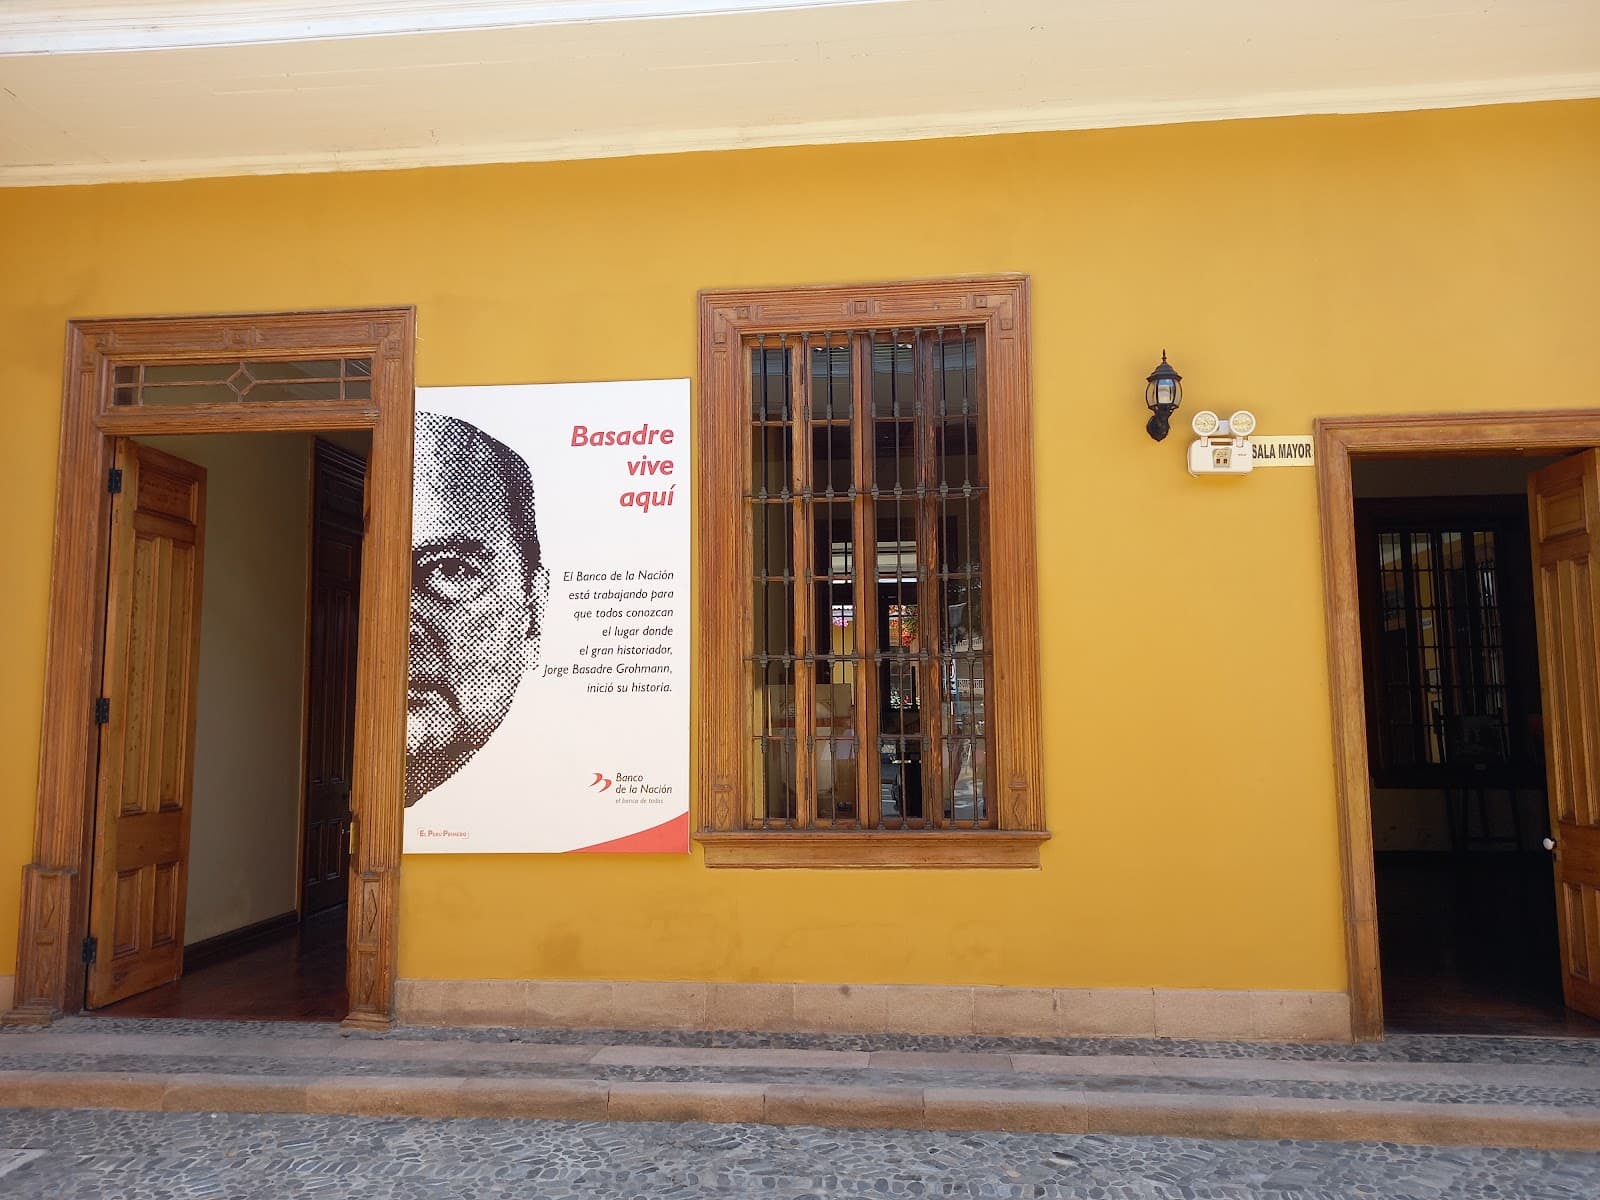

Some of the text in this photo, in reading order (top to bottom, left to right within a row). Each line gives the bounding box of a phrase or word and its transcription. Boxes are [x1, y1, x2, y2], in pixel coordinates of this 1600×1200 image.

[570, 424, 674, 447] Basadre
[1252, 443, 1312, 459] SALA MAYOR
[627, 455, 674, 476] vive
[619, 484, 676, 513] aquí
[563, 570, 674, 581] El Banco de la Nación
[568, 589, 674, 602] está trabajando para
[573, 607, 674, 621] que todos conozcan
[602, 625, 674, 639] el lugar donde
[579, 644, 673, 658] el gran historiador,
[542, 663, 673, 678] Jorge Basadre Grohmann,
[587, 682, 672, 693] inició su historia.
[615, 772, 644, 782] Banco
[615, 783, 673, 794] de la Nación
